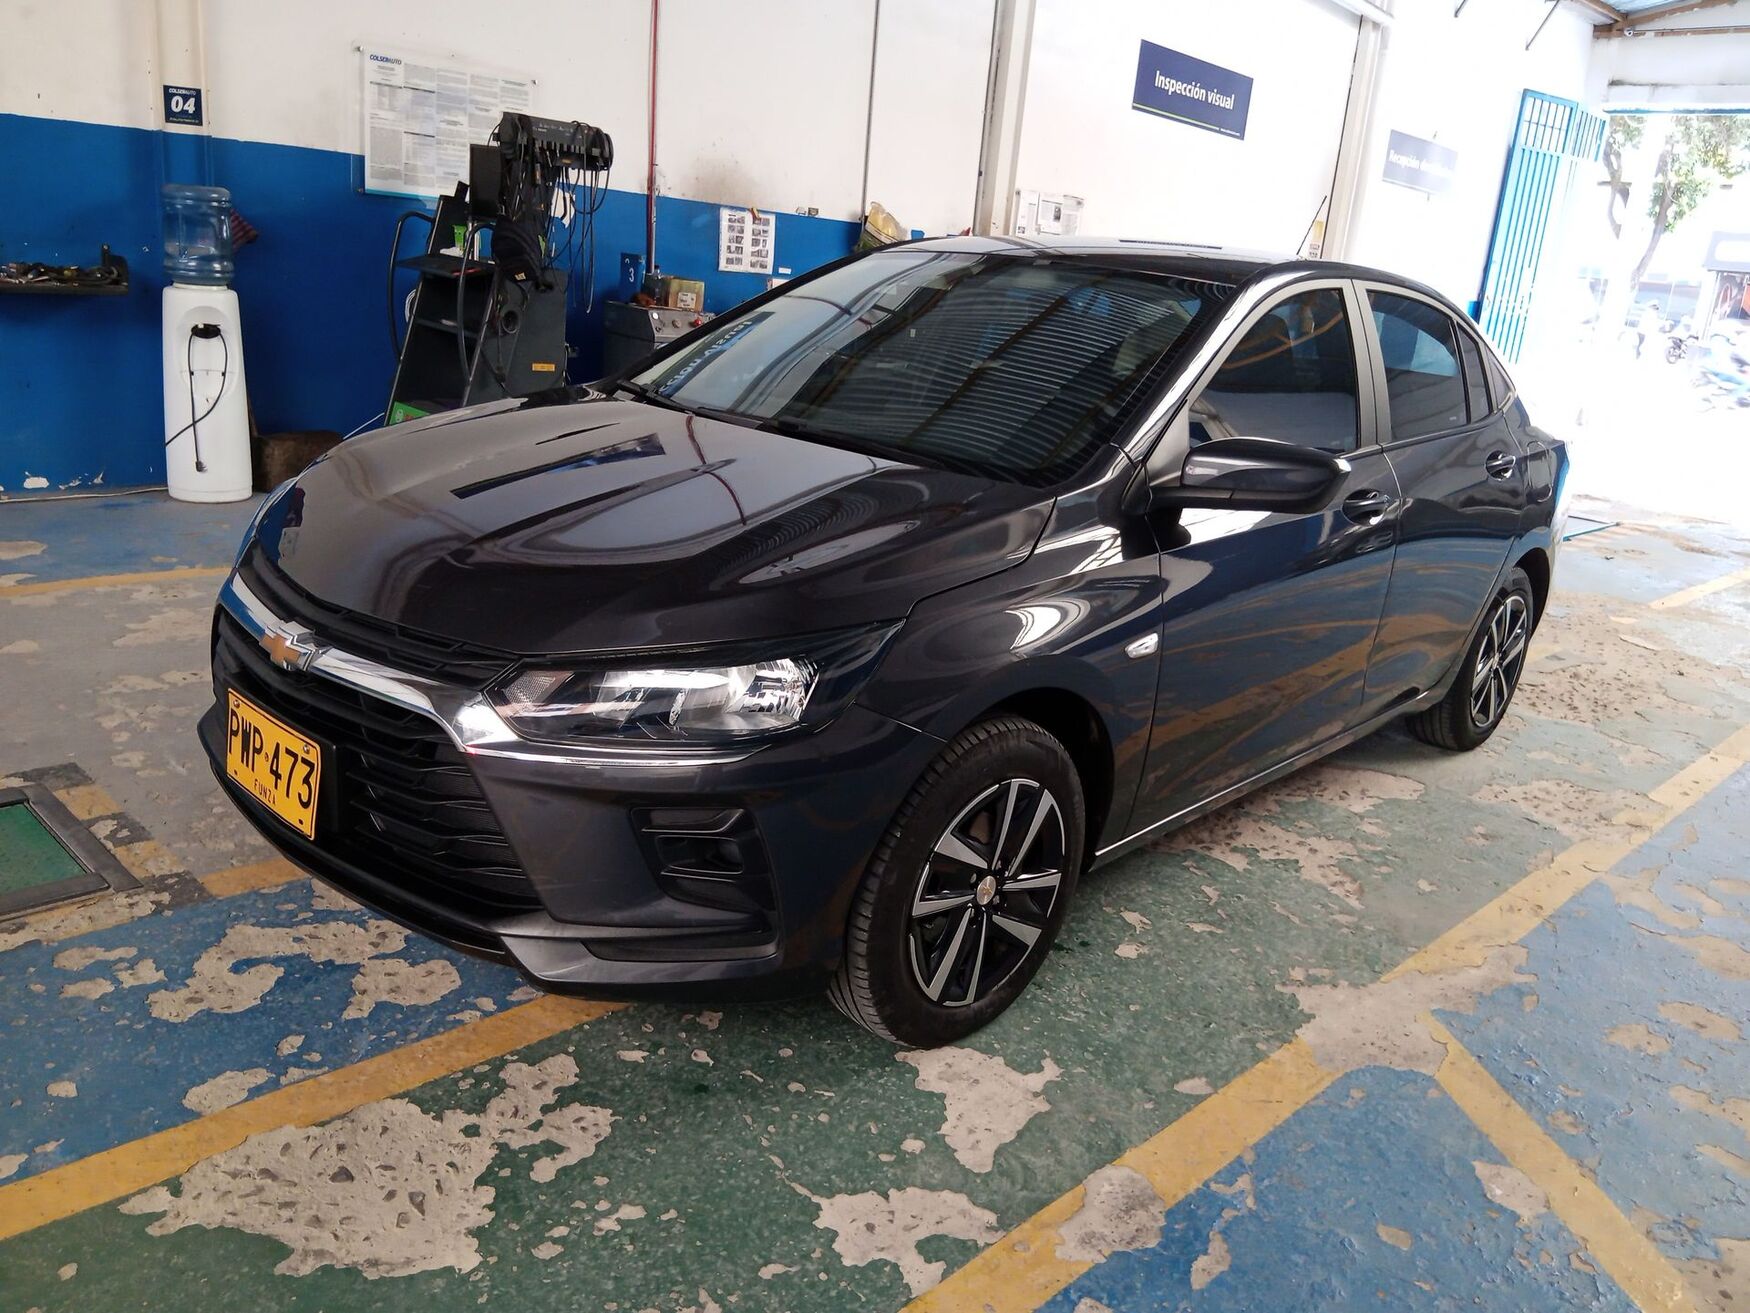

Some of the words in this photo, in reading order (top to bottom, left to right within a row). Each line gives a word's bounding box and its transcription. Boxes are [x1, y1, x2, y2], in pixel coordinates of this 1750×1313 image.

[1154, 70, 1206, 101] Inspección
[1207, 89, 1235, 110] visual
[171, 95, 196, 114] 04
[253, 778, 277, 806] FUNZA
